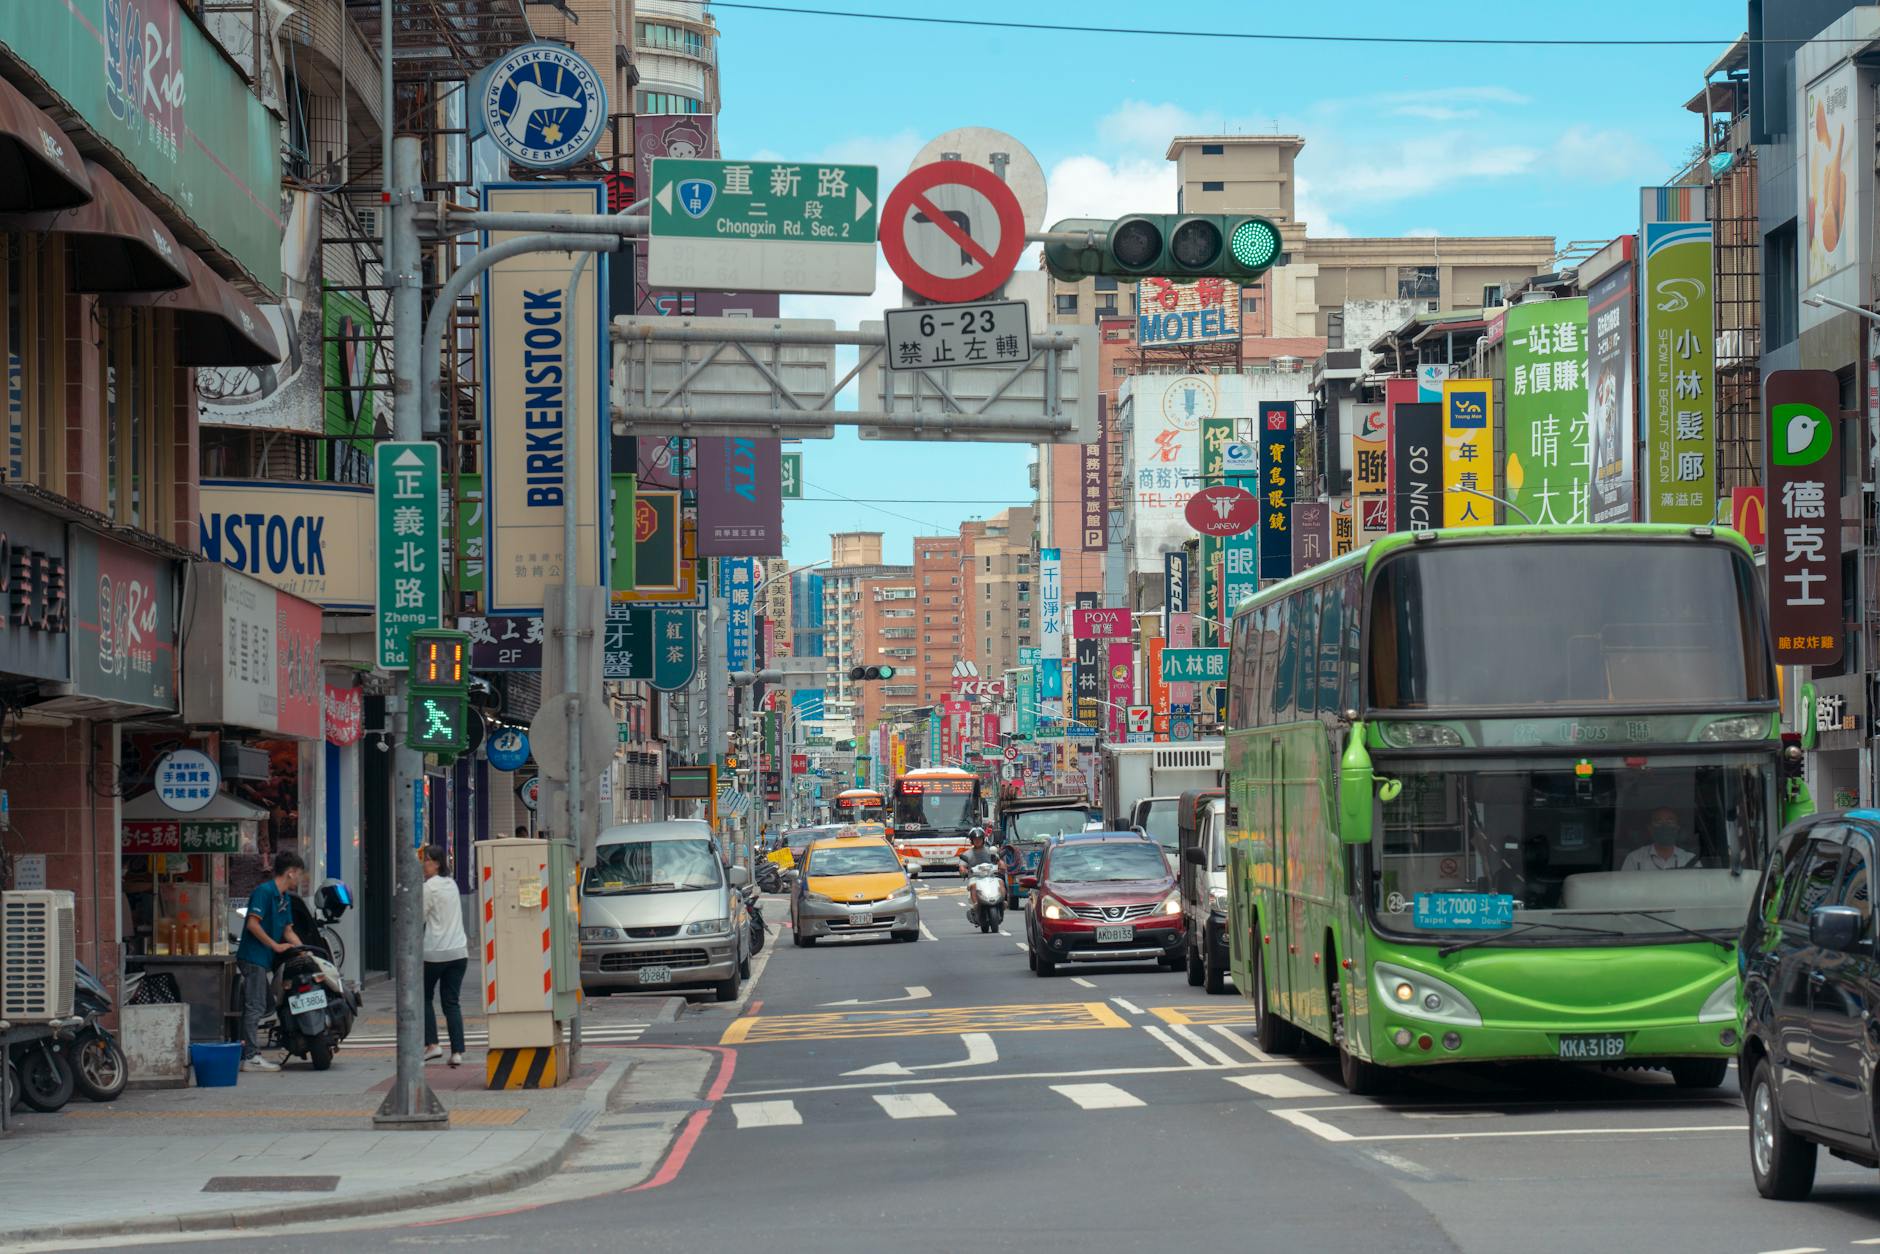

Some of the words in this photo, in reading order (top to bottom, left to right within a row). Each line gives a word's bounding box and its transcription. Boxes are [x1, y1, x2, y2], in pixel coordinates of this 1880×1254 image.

[506, 52, 595, 101] BIRKENSTOCK
[489, 86, 501, 127] MADE
[500, 133, 514, 147] IN
[521, 127, 590, 159] GERMANY
[691, 184, 699, 199] 1
[722, 165, 849, 199] 重新路
[690, 199, 702, 212] 甲
[748, 200, 823, 220] 二段
[717, 218, 776, 237] Chongxin
[783, 220, 804, 235] Rd.
[811, 221, 838, 236] Sec.
[841, 222, 849, 237] 2
[920, 310, 996, 338] 6-23
[1140, 309, 1236, 344] MOTEL
[899, 334, 1020, 364] 禁止左轉
[525, 289, 564, 507] BIRKENSTOCK
[1658, 389, 1668, 436] BEAUTY
[1676, 329, 1704, 482] 小林髮廊
[1150, 429, 1182, 463] 名
[1410, 446, 1428, 474] SO
[734, 437, 757, 503] KTV
[1658, 441, 1668, 482] SALON
[1086, 444, 1101, 527] 商務汽車旅館
[1269, 443, 1287, 531] 寶島眼鏡
[1459, 443, 1478, 521] 年青人
[393, 471, 425, 608] 正義北路
[1089, 532, 1099, 545] P
[1782, 481, 1827, 606] 德克士
[300, 579, 326, 593] 1774
[732, 557, 749, 625] 鼻喉科
[1043, 567, 1059, 634] 千山淨水
[127, 581, 158, 648] Rio
[384, 612, 437, 626] Zheng-
[1085, 613, 1118, 622] POYA
[385, 627, 398, 638] yi
[385, 640, 398, 650] N.
[666, 610, 684, 663] 紅茶
[1778, 636, 1834, 650] 脆皮炸雞
[385, 652, 408, 663] Rd.
[429, 643, 462, 681] 11
[499, 649, 522, 663] 2F
[1164, 655, 1224, 677] 小林眼
[959, 681, 1001, 695] KFC
[184, 825, 239, 847] 楊桃汁
[1419, 916, 1447, 925] Taipei
[1449, 898, 1476, 914] 7000
[1560, 1038, 1624, 1056] KKA-3189
